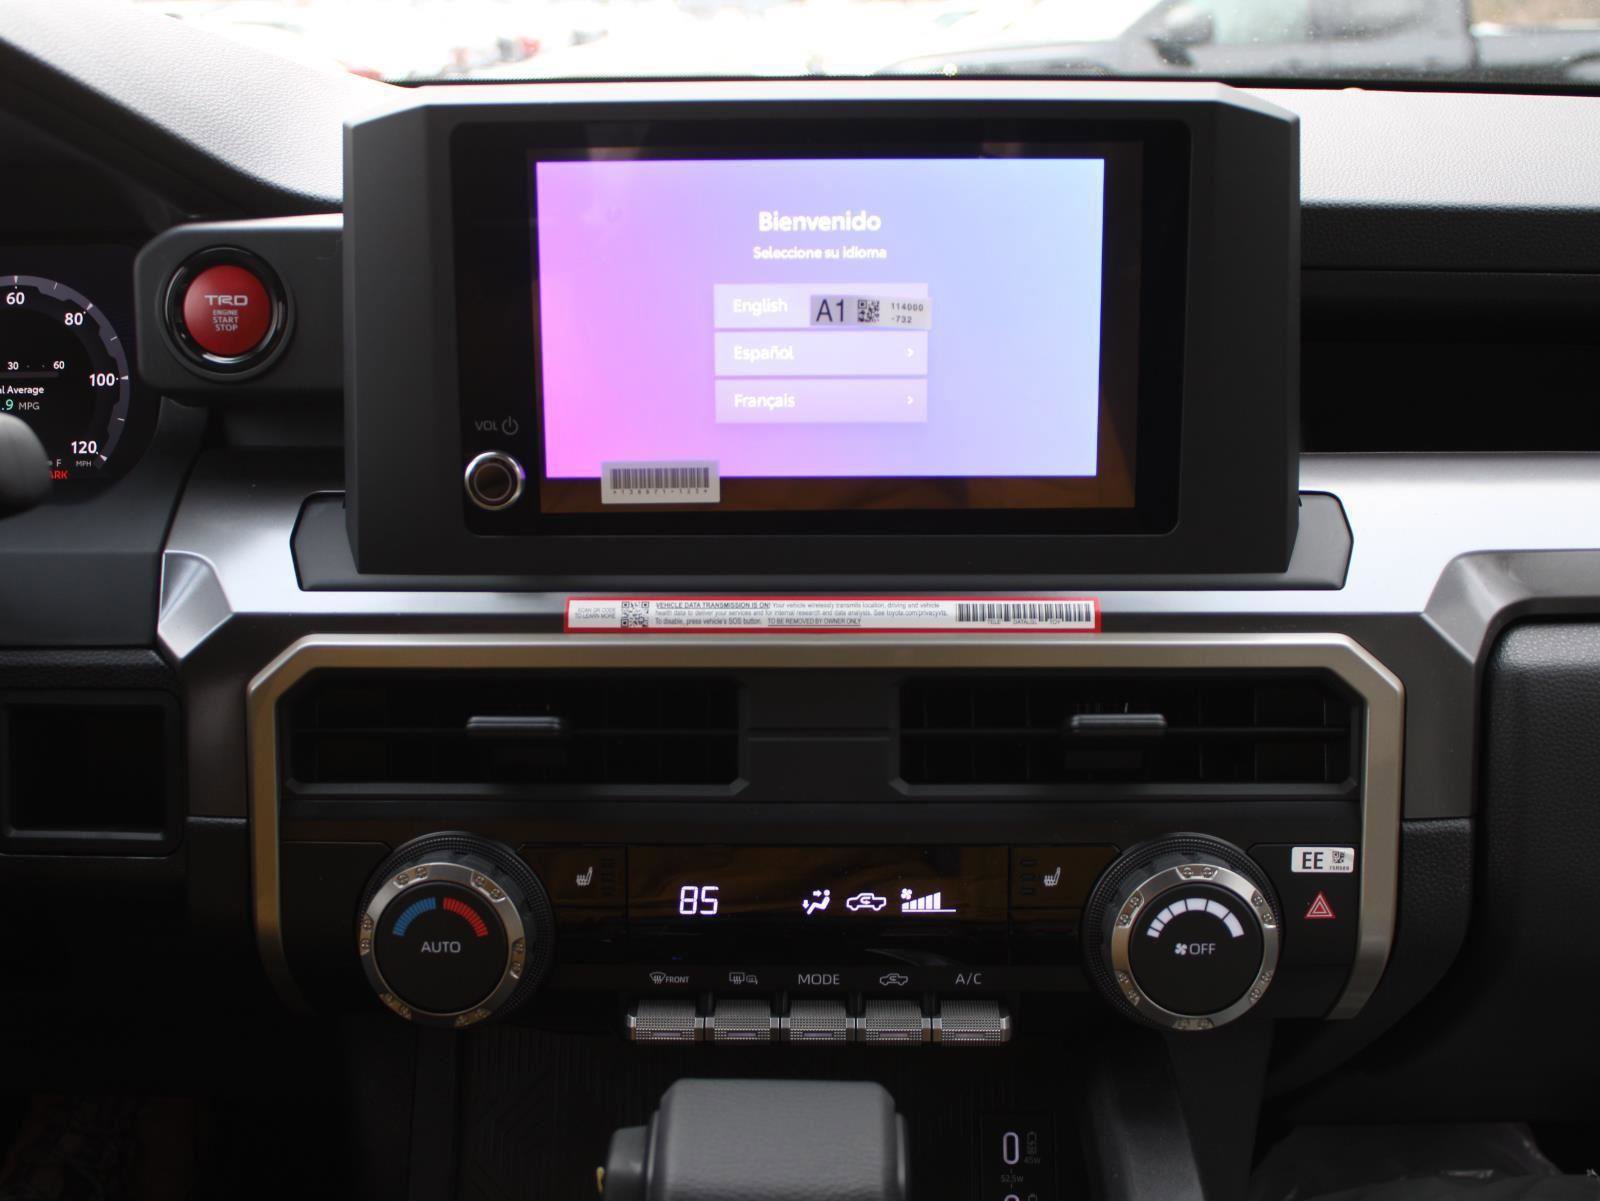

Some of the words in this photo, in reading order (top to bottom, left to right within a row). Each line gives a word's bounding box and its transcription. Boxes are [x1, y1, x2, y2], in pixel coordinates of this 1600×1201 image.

[758, 210, 882, 232] Bienvenido
[752, 245, 822, 260] Seleccione
[824, 247, 840, 260] su
[842, 245, 888, 260] idioma
[6, 291, 25, 306] 60
[204, 294, 249, 306] TRD
[732, 298, 788, 316] English
[815, 298, 845, 323] A1
[64, 312, 83, 327] 80
[214, 323, 239, 332] STOP
[733, 345, 795, 362] Español
[7, 361, 19, 370] 30
[53, 360, 65, 370] 60
[88, 372, 116, 387] 100
[6, 385, 45, 396] Average
[18, 401, 40, 411] MPG
[734, 393, 796, 410] Français
[474, 419, 498, 431] VOL
[71, 440, 97, 454] 120
[75, 460, 92, 468] MPH
[48, 469, 68, 480] ARK
[656, 602, 683, 610] VEHICLE
[685, 602, 701, 610] DATA
[702, 602, 750, 610] TRANSMISSION
[777, 618, 784, 626] BE
[786, 618, 815, 626] REMOVED
[816, 618, 823, 626] BY
[824, 618, 846, 626] OWNER
[847, 618, 861, 626] ONLY
[1302, 852, 1324, 870] EE
[679, 886, 720, 915] 85
[421, 941, 461, 954] AUTO
[1189, 943, 1216, 956] OFF
[665, 975, 689, 984] FRONT
[797, 973, 840, 986] MODE
[955, 973, 983, 985] A/C
